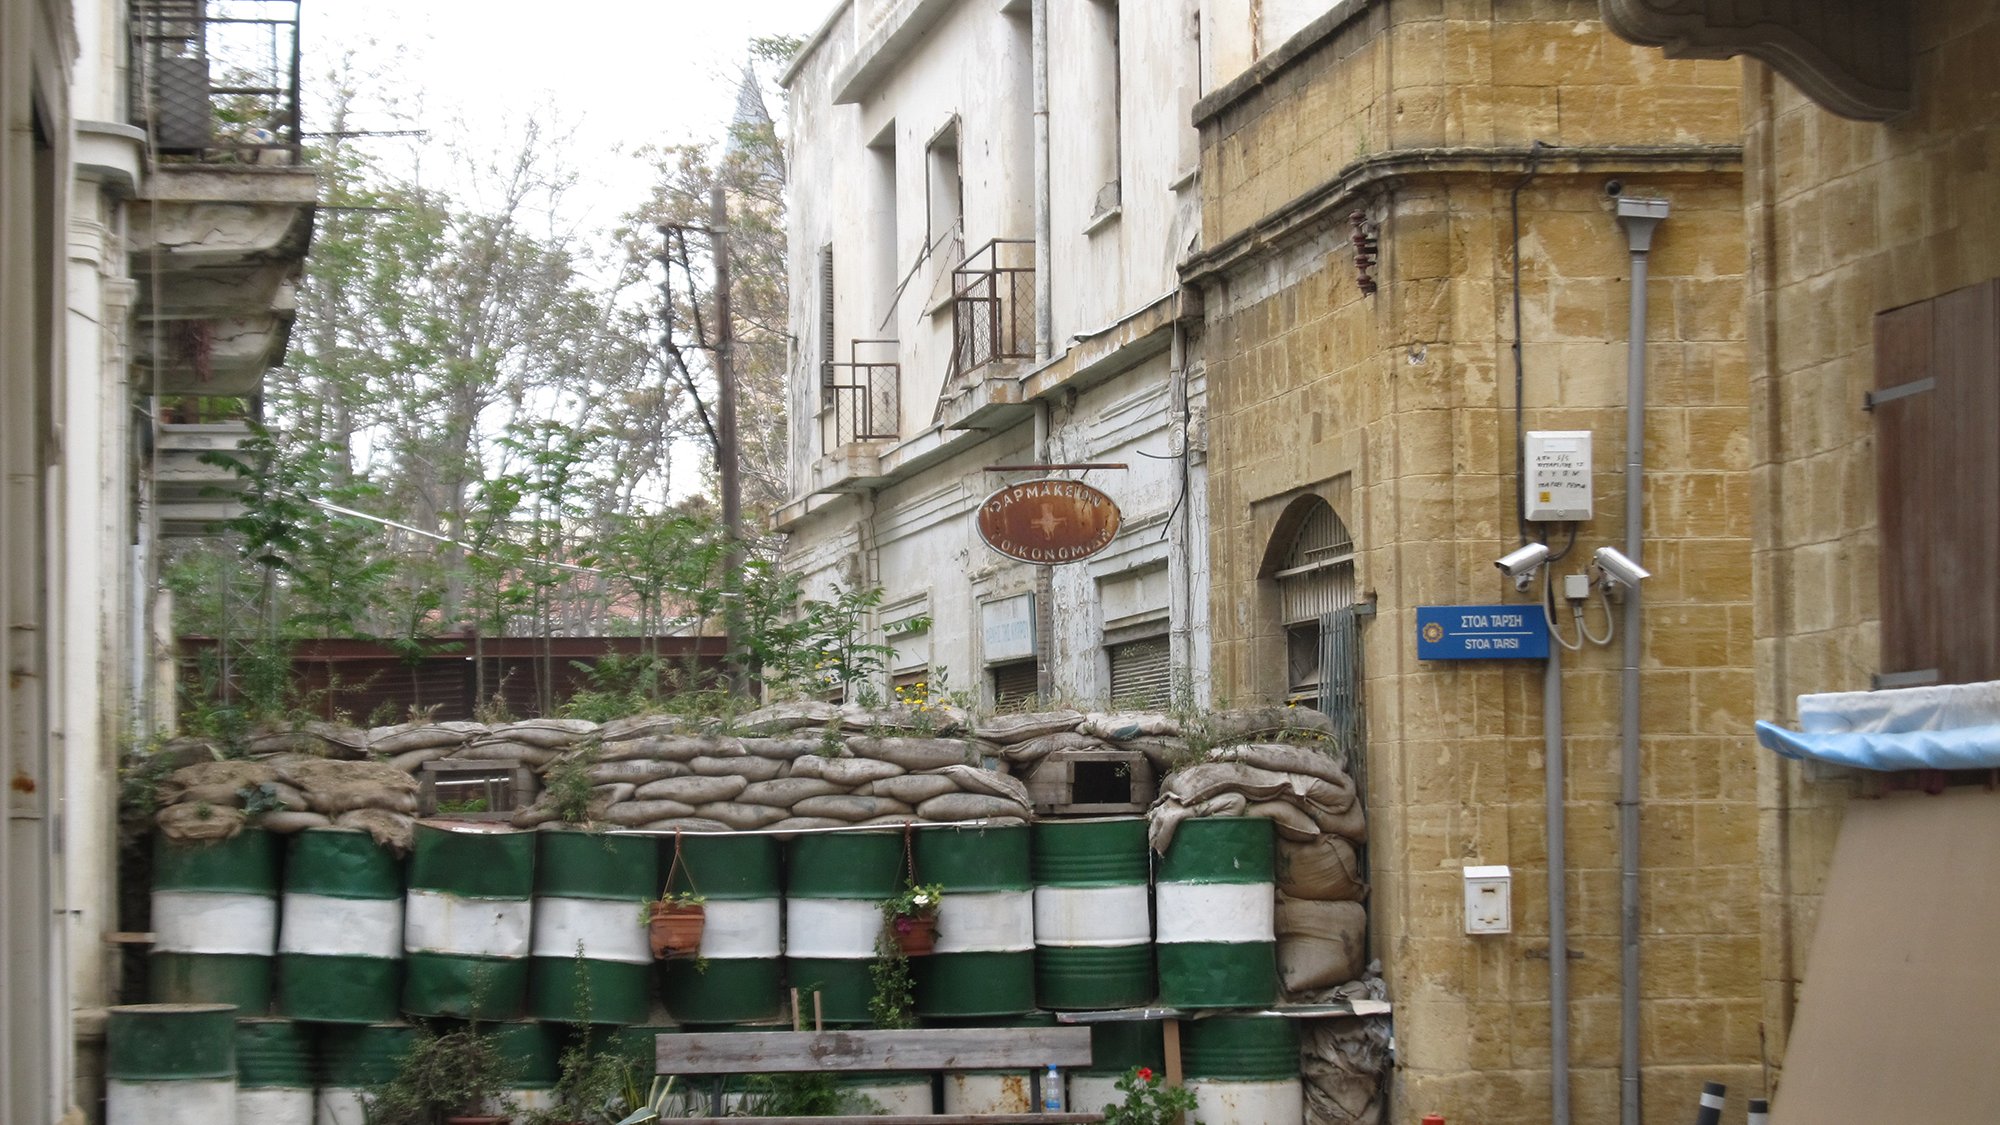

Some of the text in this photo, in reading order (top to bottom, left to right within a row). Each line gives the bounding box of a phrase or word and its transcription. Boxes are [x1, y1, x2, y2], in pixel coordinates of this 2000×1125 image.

[1461, 615, 1522, 628] ΣΤΟΑ ΤΑΡΣΗ
[1465, 638, 1519, 649] STOA TARSI
